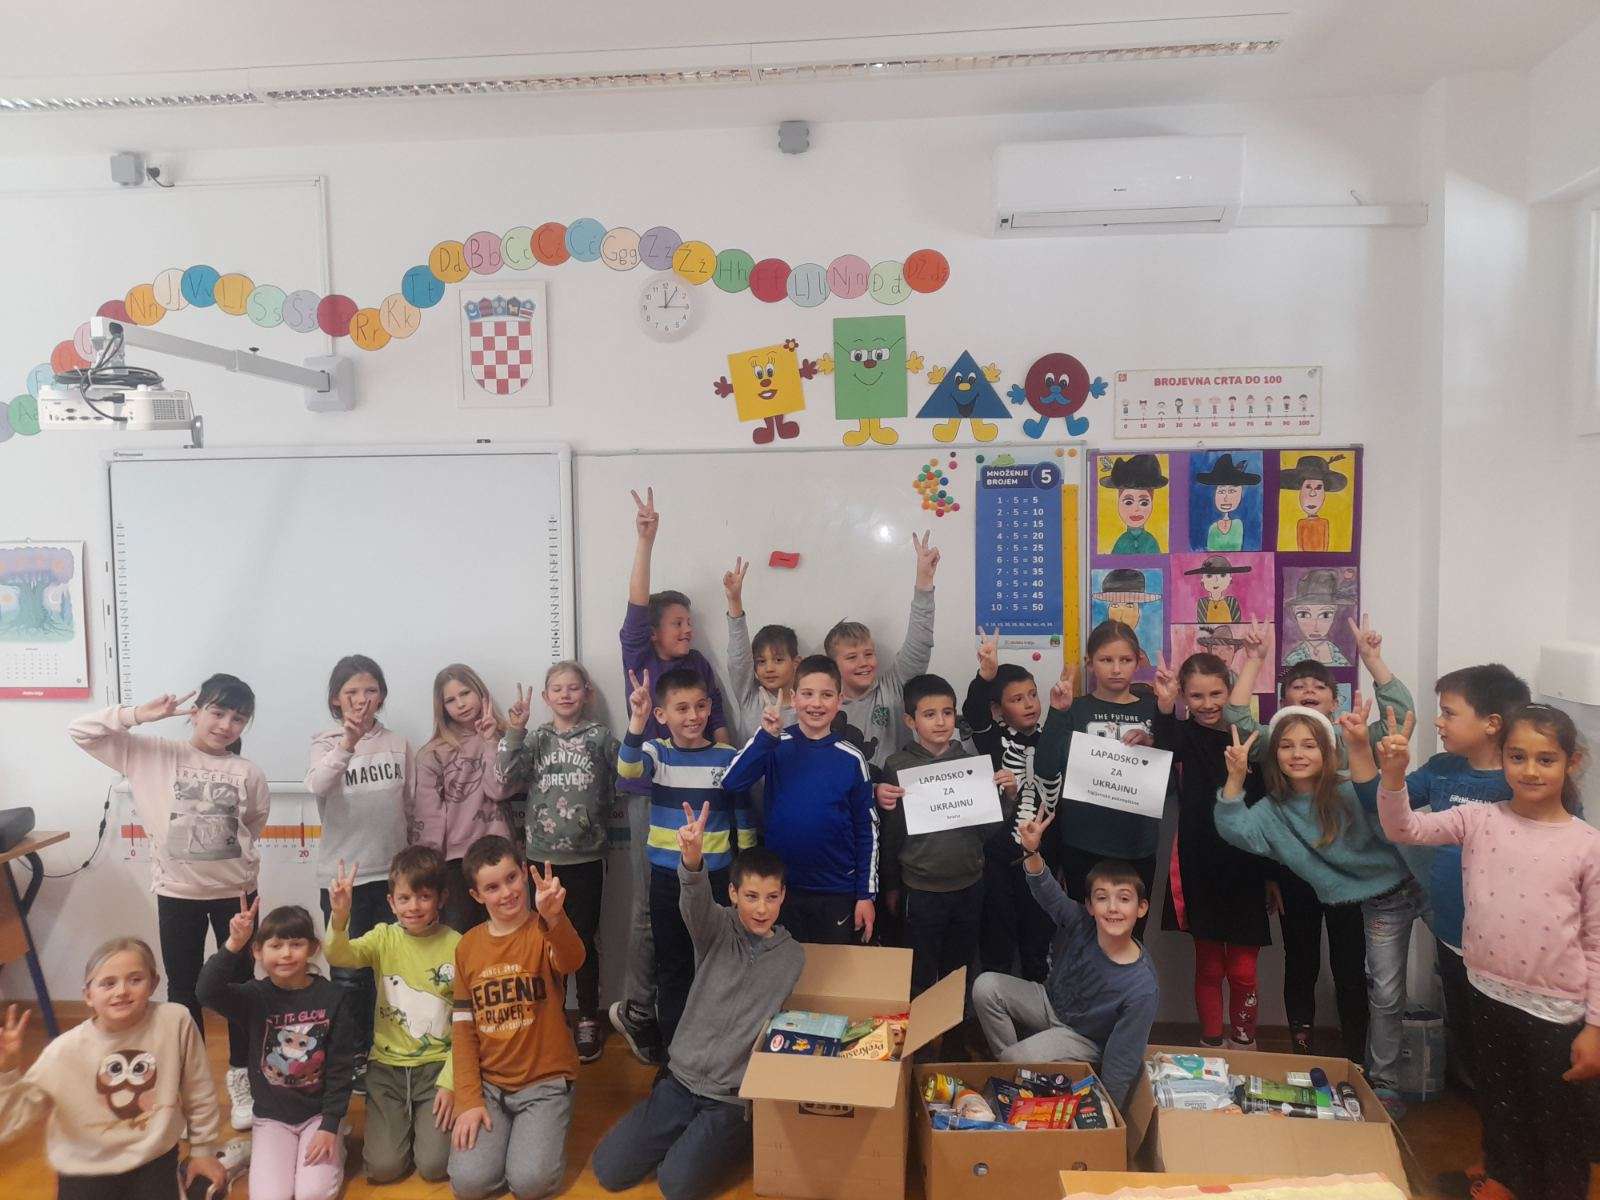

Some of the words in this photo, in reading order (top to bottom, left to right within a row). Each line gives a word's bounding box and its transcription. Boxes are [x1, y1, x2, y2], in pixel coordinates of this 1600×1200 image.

[1154, 377, 1211, 387] BROJEVNA
[1213, 376, 1242, 386] CRTA
[1245, 375, 1260, 385] DO
[1263, 375, 1283, 384] 100
[986, 469, 1029, 477] MNOŽENJE
[1040, 469, 1052, 484] 5
[996, 496, 1003, 504] 1
[1013, 496, 1020, 504] 5
[1032, 496, 1040, 504] 5
[996, 508, 1003, 516] 2
[1013, 508, 1020, 516] 5
[1032, 508, 1044, 516] 10
[1013, 520, 1020, 528] 5
[1032, 520, 1044, 528] 15
[996, 532, 1003, 540] 4
[1013, 532, 1020, 540] 5
[1032, 532, 1044, 540] 20
[996, 544, 1003, 552] 5
[1013, 544, 1020, 552] 5
[1032, 544, 1044, 552] 25
[996, 556, 1003, 564] 6
[1013, 556, 1020, 564] 5
[1032, 556, 1044, 564] 30
[996, 567, 1003, 576] 7
[1013, 567, 1020, 576] 5
[1032, 567, 1044, 576] 35
[996, 579, 1003, 588] 8
[1013, 579, 1020, 588] 5
[1032, 579, 1044, 588] 40
[996, 592, 1003, 600] 9
[1013, 592, 1020, 600] 5
[1032, 592, 1044, 600] 45
[991, 603, 1003, 612] 10
[1013, 603, 1020, 612] 5
[1032, 603, 1044, 612] 50
[1111, 713, 1139, 722] FUTURE
[1091, 748, 1139, 766] LAPADSKO
[536, 751, 594, 774] AVENTURE
[1110, 768, 1123, 777] ZA
[919, 770, 965, 785] LAPADSKO
[1092, 778, 1138, 795] UKRAJINU
[943, 787, 955, 796] ZA
[930, 798, 974, 812] UKRAJINU
[130, 848, 136, 857] 0
[298, 850, 310, 858] 20
[485, 1004, 525, 1024] PLAYER
